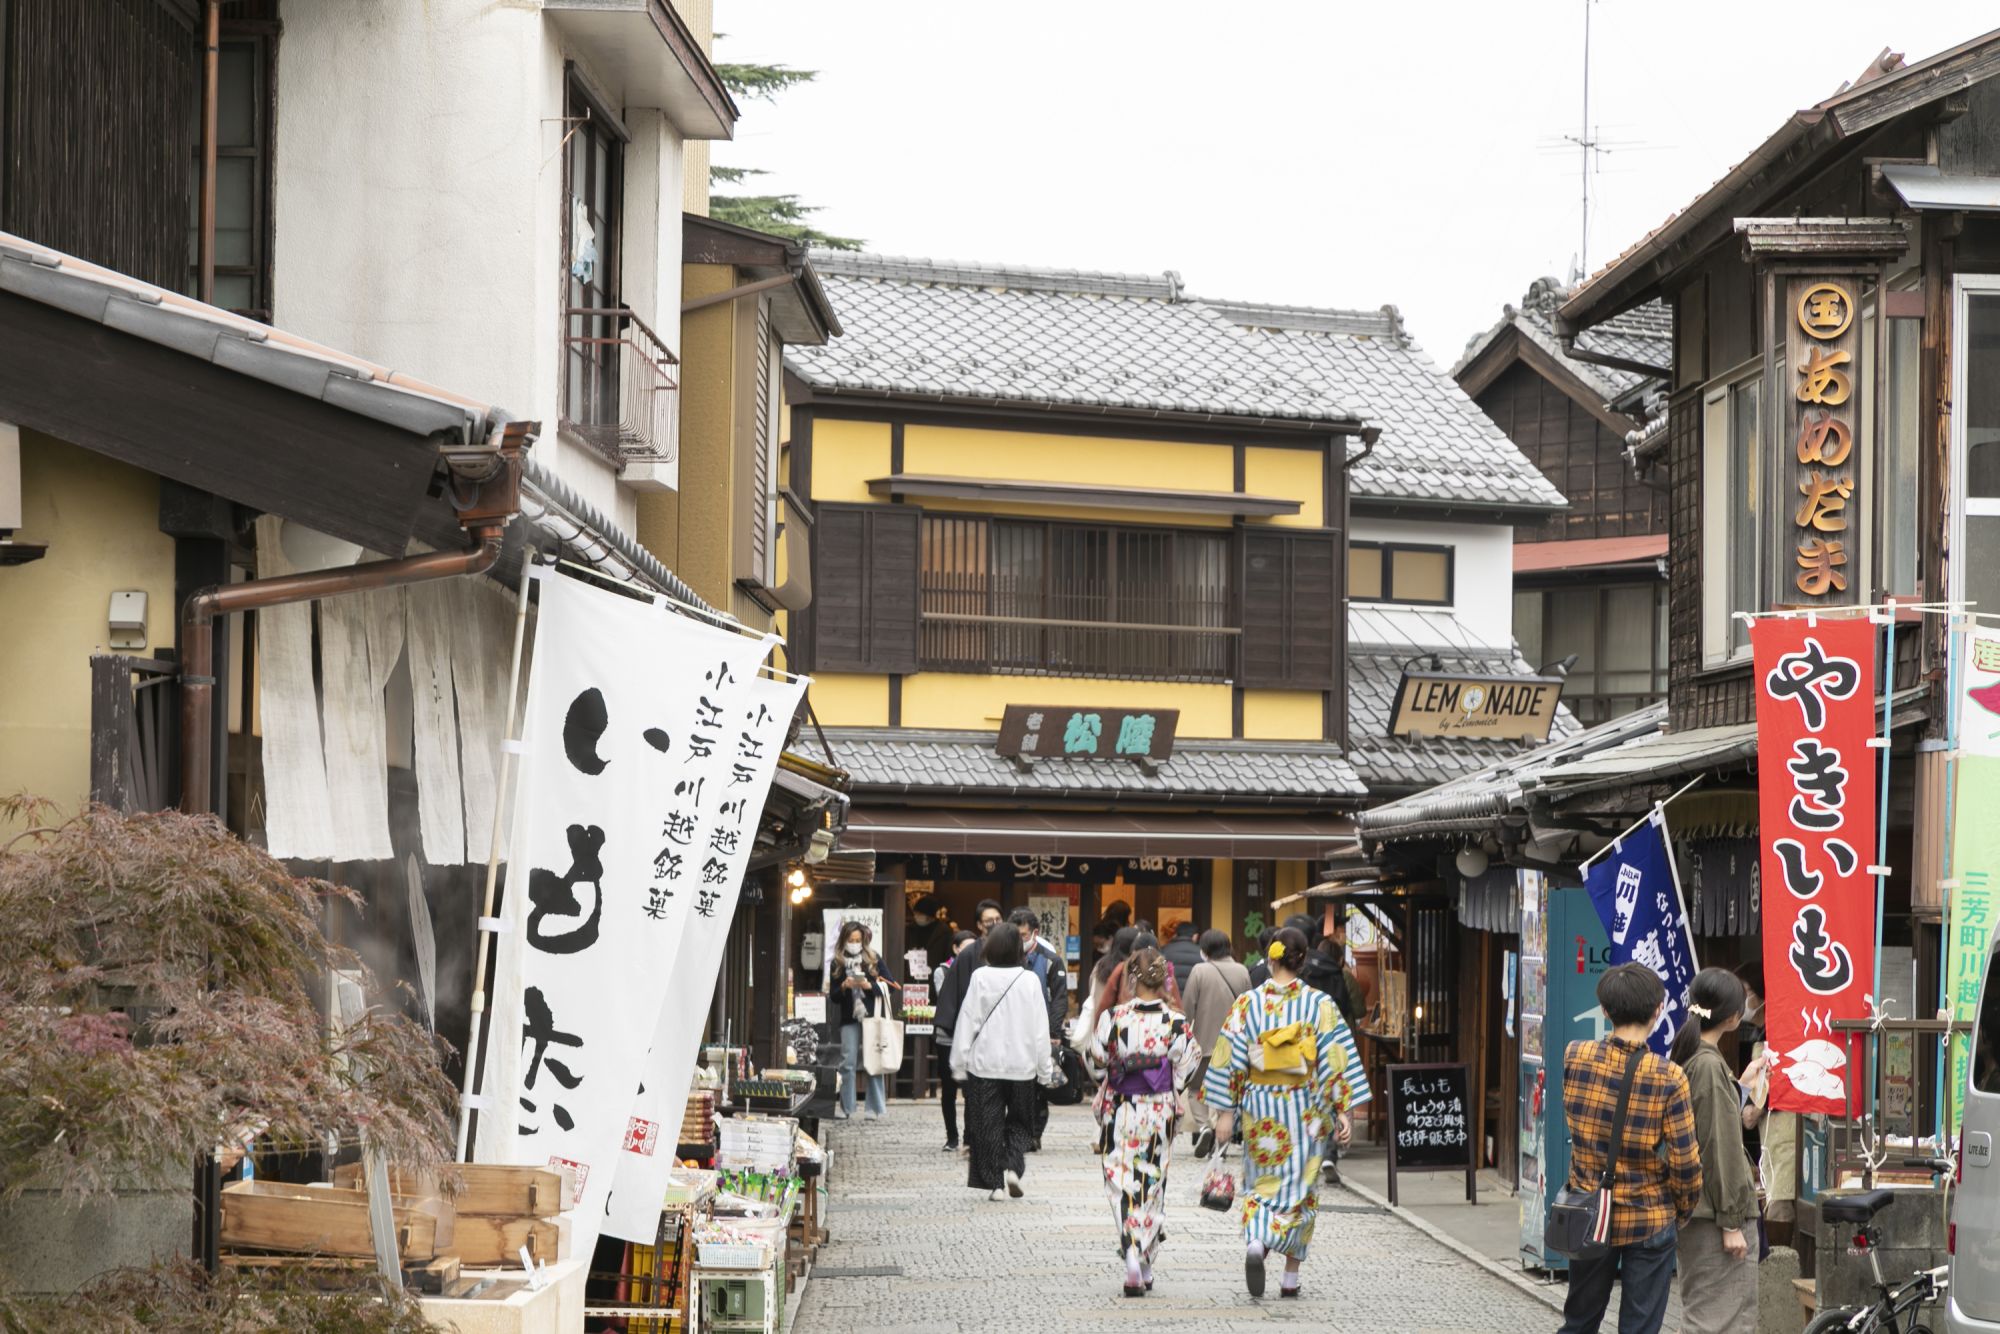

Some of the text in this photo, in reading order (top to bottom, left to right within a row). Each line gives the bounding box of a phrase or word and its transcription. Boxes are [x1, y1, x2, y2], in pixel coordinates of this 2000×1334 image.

[1796, 347, 1854, 596] あめだま
[642, 661, 737, 920] 小江戸川越銘菓
[694, 703, 774, 919] 小江戸川越銘菓
[1064, 713, 1156, 754] 松陸
[1438, 717, 1450, 731] by
[1766, 637, 1860, 995] やきいも
